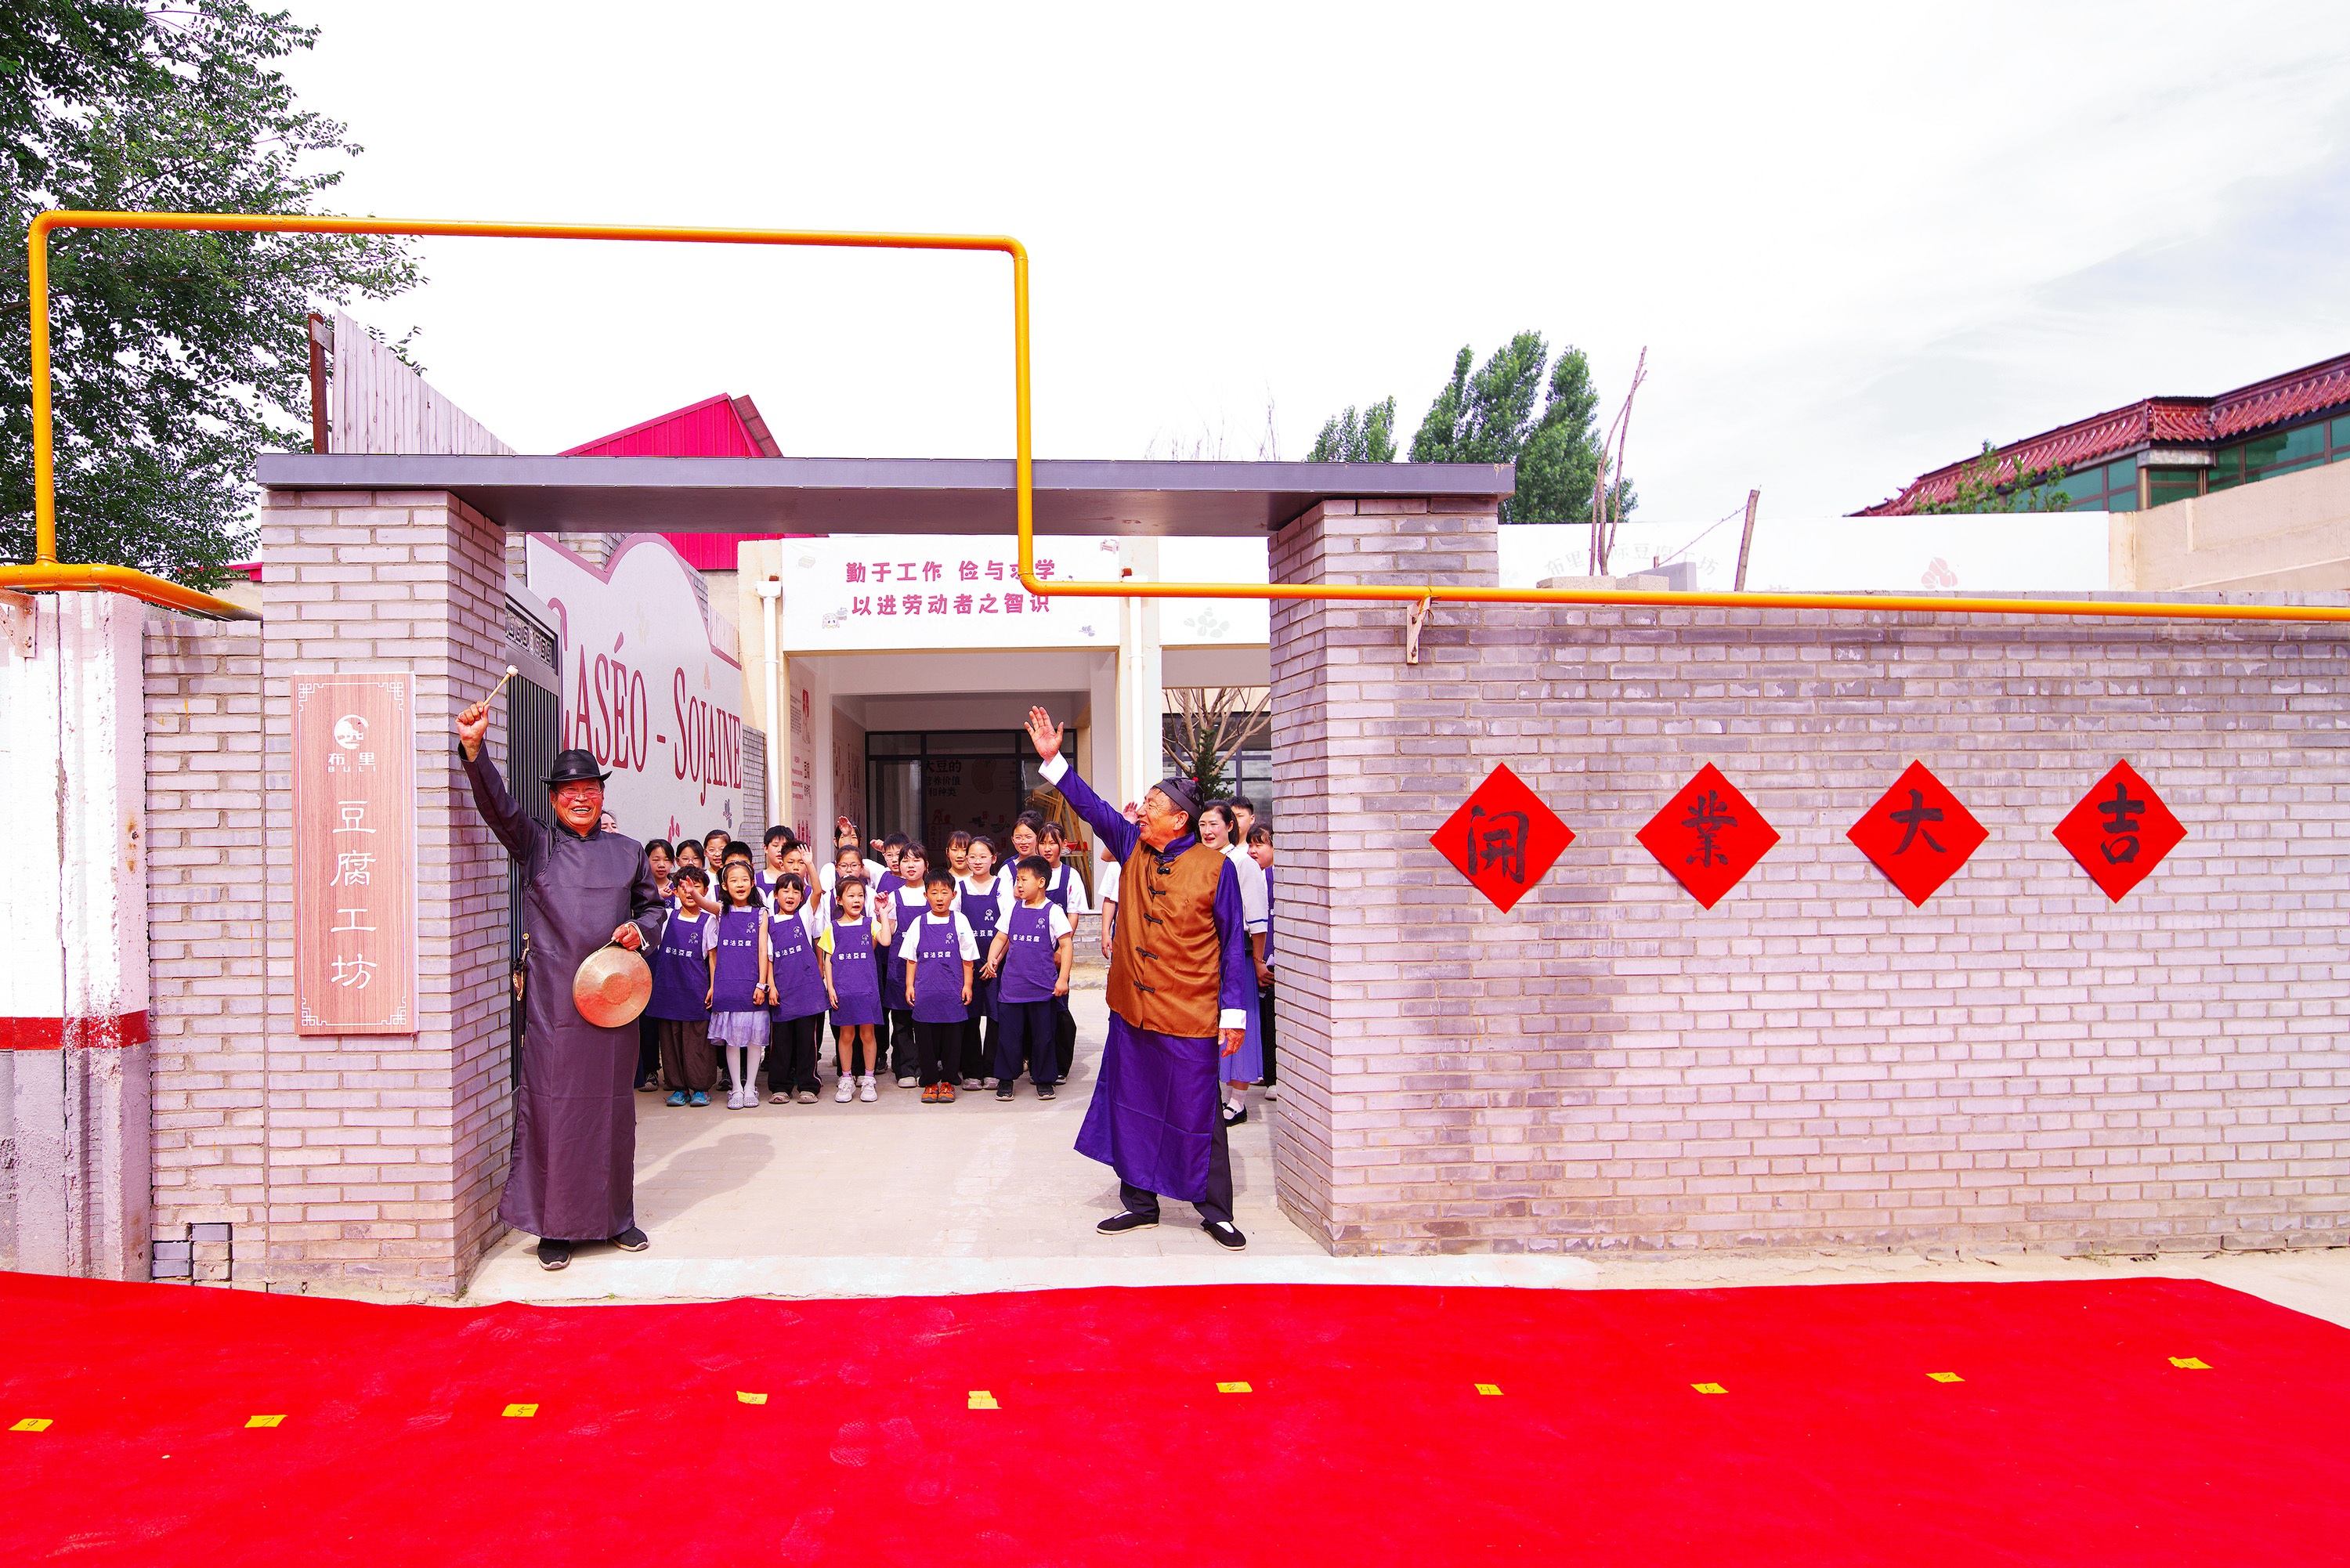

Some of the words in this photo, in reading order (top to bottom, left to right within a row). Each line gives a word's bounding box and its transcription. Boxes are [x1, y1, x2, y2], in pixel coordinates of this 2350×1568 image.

[1543, 542, 1719, 577] 布里际豆腐工坊
[846, 561, 942, 583] 勤于工作
[851, 593, 1050, 616] 以进劳动者之智识
[327, 752, 375, 766] 布里
[926, 760, 962, 773] 大豆的
[329, 800, 378, 990] 豆腐工坊
[1480, 1386, 1499, 1394] 4
[514, 1407, 533, 1417] 5
